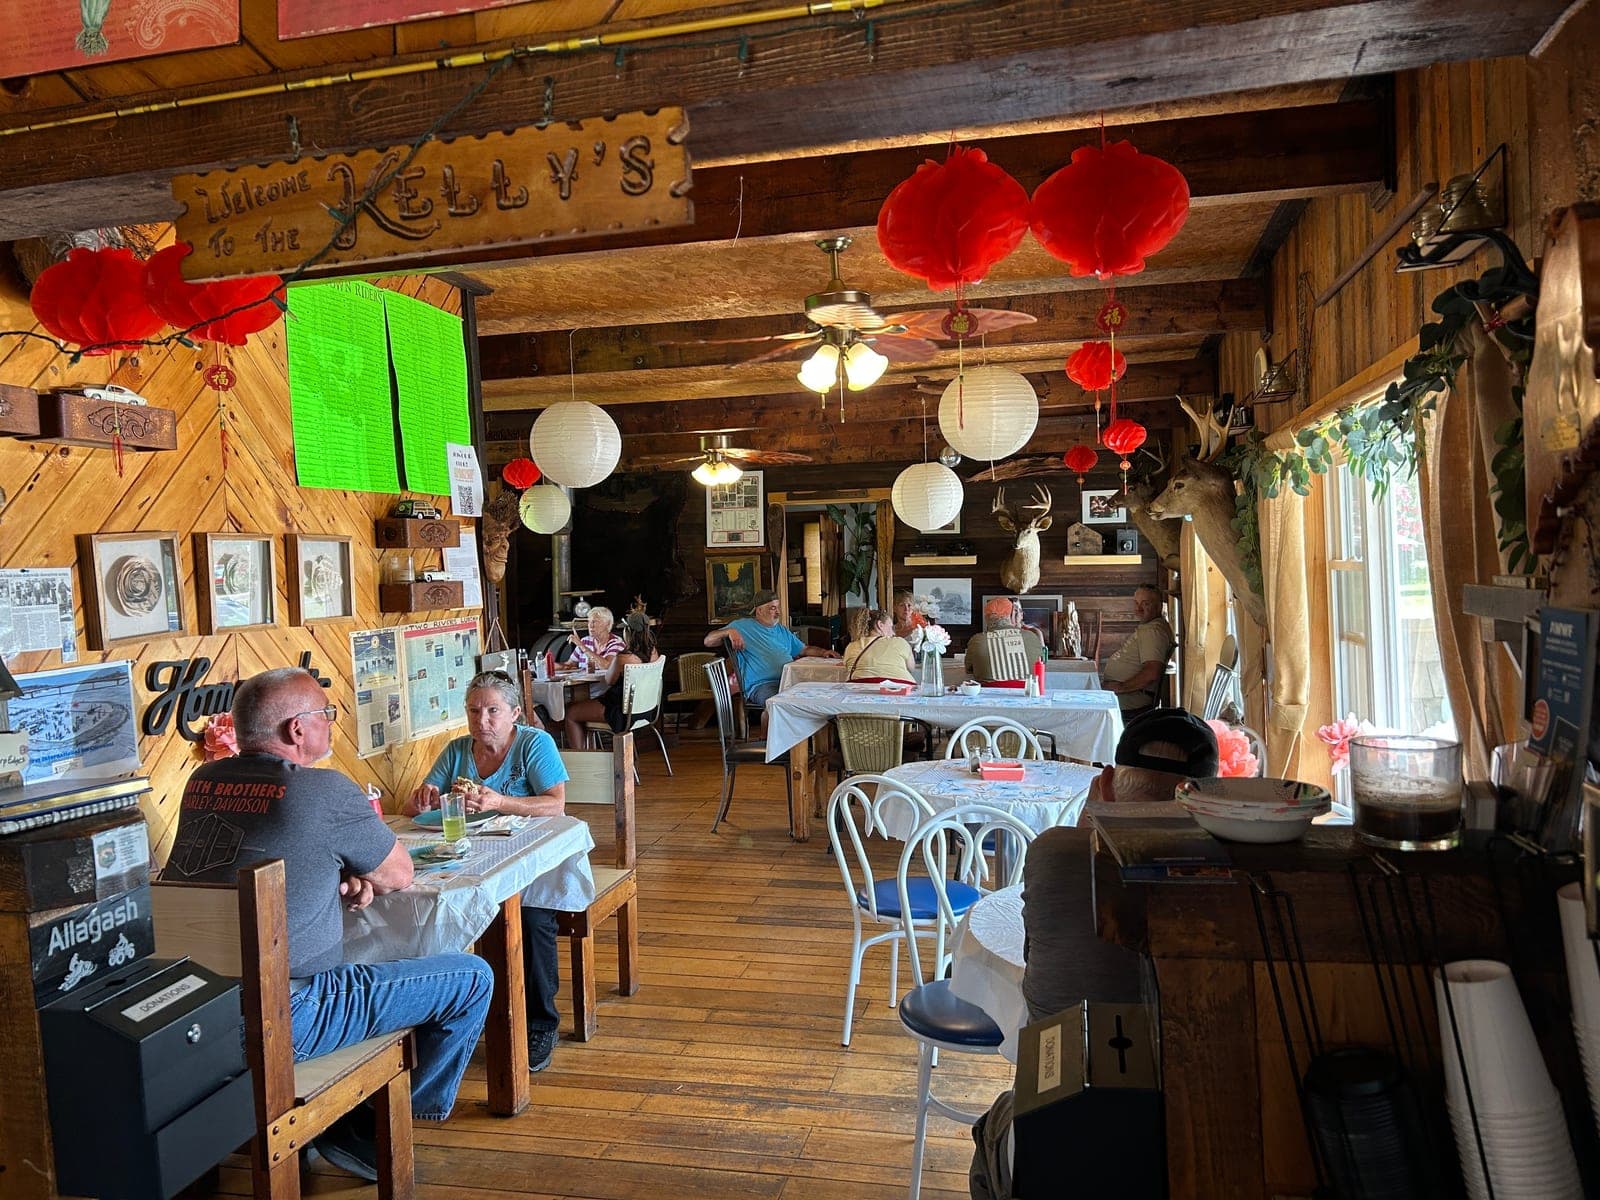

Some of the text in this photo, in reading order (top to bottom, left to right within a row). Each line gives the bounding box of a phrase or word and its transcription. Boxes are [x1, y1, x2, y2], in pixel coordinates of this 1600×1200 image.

[194, 169, 312, 224] Welcome
[327, 133, 655, 250] KELLY'S
[354, 284, 383, 304] RIDERS
[408, 622, 429, 631] TWO
[214, 783, 287, 799] BROTHERS
[47, 897, 138, 957] Allagash
[139, 983, 191, 1013] DONATIONS
